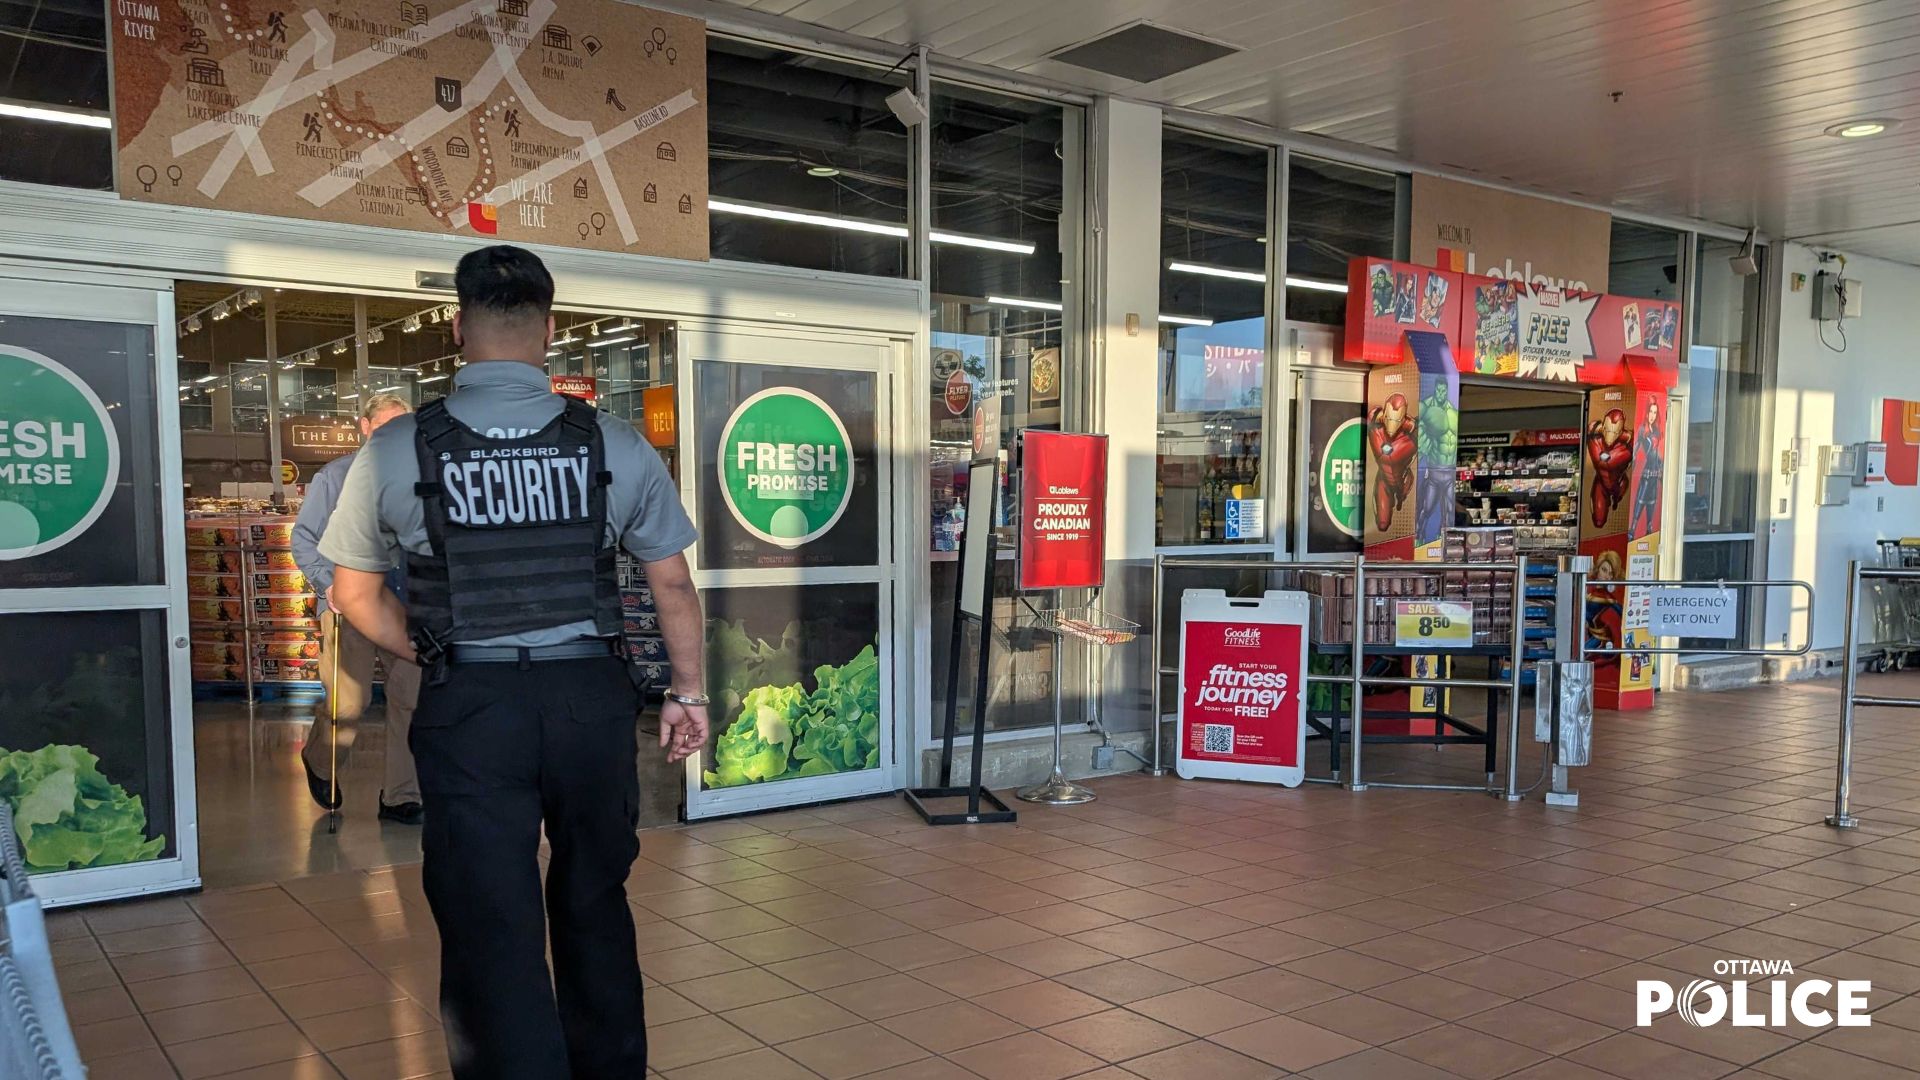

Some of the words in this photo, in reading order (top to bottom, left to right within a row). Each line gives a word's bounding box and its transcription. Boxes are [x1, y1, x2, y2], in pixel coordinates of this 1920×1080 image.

[118, 0, 160, 21] OTTAWA
[124, 20, 155, 40] RIVER
[327, 13, 359, 33] OTTAWA
[361, 19, 389, 37] PUBLIC
[455, 23, 504, 45] COMMUNITY
[248, 41, 268, 58] MUD
[270, 44, 288, 62] LAKE
[369, 38, 428, 60] CARLINGWOOD
[249, 59, 272, 76] TRAIL
[542, 66, 565, 80] ARENA
[441, 83, 456, 103] 417
[186, 104, 227, 123] LAKESIDE
[229, 111, 261, 128] CENTRE
[633, 108, 662, 131] BASELINE
[296, 142, 337, 160] PINECREST
[339, 149, 363, 163] CREEK
[510, 139, 560, 158] EXPERIMENTAL
[561, 148, 581, 162] FARM
[329, 163, 364, 180] PATHWAY
[421, 146, 449, 190] WOODROFFE
[510, 155, 541, 171] PATHWAY
[355, 182, 386, 198] OTTAWA
[387, 185, 404, 200] FIRE
[511, 178, 529, 202] WE
[532, 181, 554, 205] ARE
[360, 199, 394, 215] STATION
[395, 203, 404, 217] 21
[519, 203, 547, 228] HERE
[1437, 223, 1463, 244] WELCOME
[1464, 227, 1471, 245] TO
[1526, 312, 1570, 345] FREE
[1522, 354, 1538, 362] EVERY
[1554, 357, 1571, 365] SPENT
[1523, 346, 1543, 355] STICKER
[1545, 347, 1559, 356] PACK
[1560, 349, 1571, 357] FOR
[555, 383, 592, 391] CANADA
[299, 431, 328, 441] THE
[470, 447, 560, 459] BLACKBIRD
[737, 441, 837, 472] FRESH
[443, 457, 589, 525] SECURITY
[747, 473, 829, 491] PROMISE
[1056, 486, 1079, 495] Loblaws
[1038, 503, 1088, 516] PROUDLY
[1033, 518, 1091, 530] CANADIAN
[1408, 604, 1435, 614] SAVE
[1656, 597, 1728, 607] EMERGENCY
[1662, 613, 1686, 623] EXIT
[1689, 614, 1721, 624] ONLY
[1224, 627, 1261, 638] GoodLife
[1224, 638, 1260, 646] FITNESS
[1209, 664, 1288, 689] fitness
[1195, 680, 1287, 711] journey
[1234, 705, 1269, 718] FREE!
